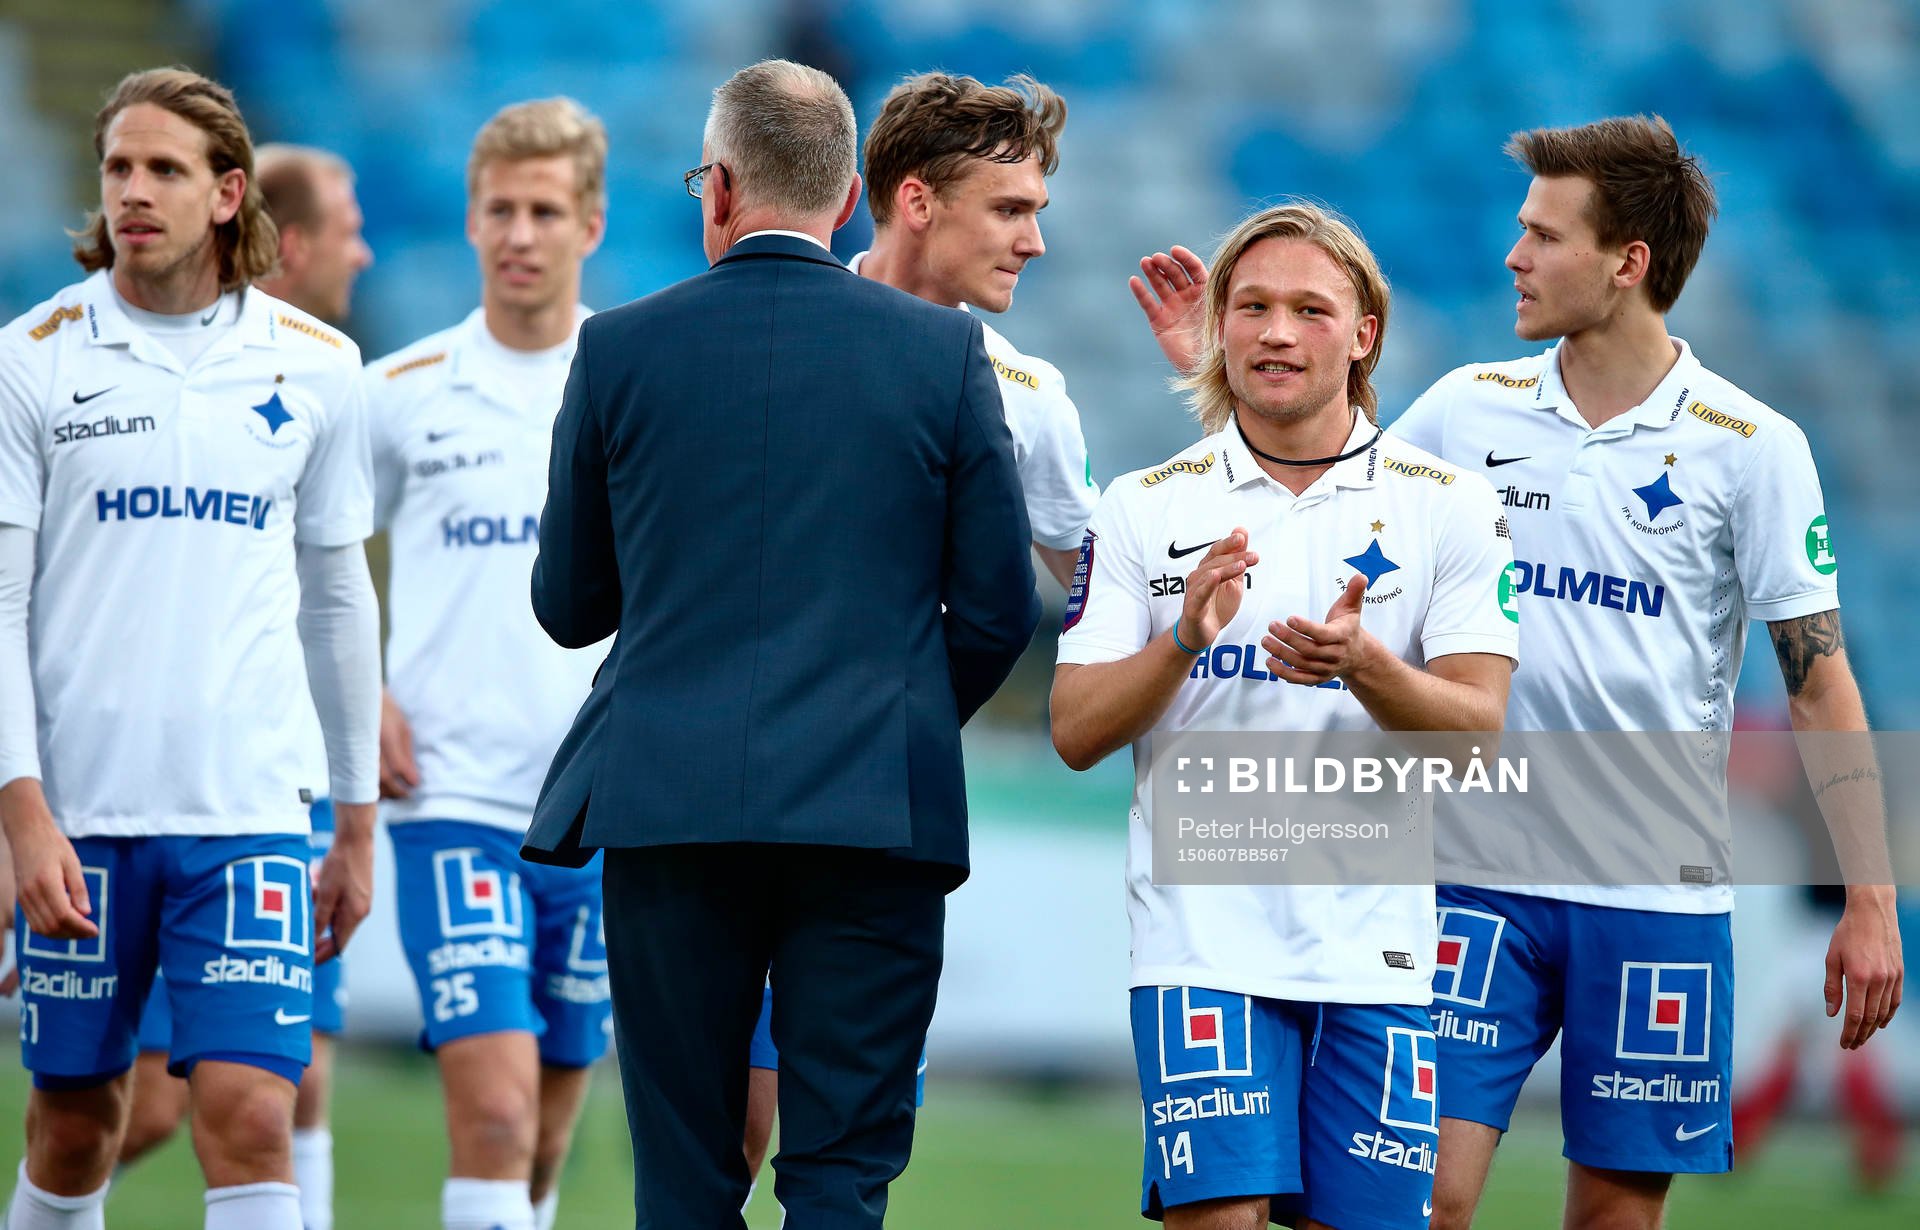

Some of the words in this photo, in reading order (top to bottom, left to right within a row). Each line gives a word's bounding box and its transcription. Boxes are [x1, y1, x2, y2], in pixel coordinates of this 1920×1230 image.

[1669, 387, 1690, 422] HOLMEN
[1691, 402, 1751, 435] LINOTOL
[54, 415, 156, 445] stadium
[1144, 456, 1214, 486] LINOTOL
[1222, 448, 1235, 483] HOLMEN
[1366, 447, 1378, 482] HOLMEN
[97, 485, 271, 530] HOLMEN
[1621, 506, 1633, 521] IFK
[1630, 519, 1685, 536] NORRKÖPING
[1335, 577, 1349, 592] IFK
[22, 966, 118, 999] tadium
[201, 954, 312, 994] stadium
[431, 972, 479, 1022] 25
[1591, 1071, 1720, 1103] stadium
[1152, 1087, 1269, 1126] stadium
[1158, 1130, 1194, 1179] 14
